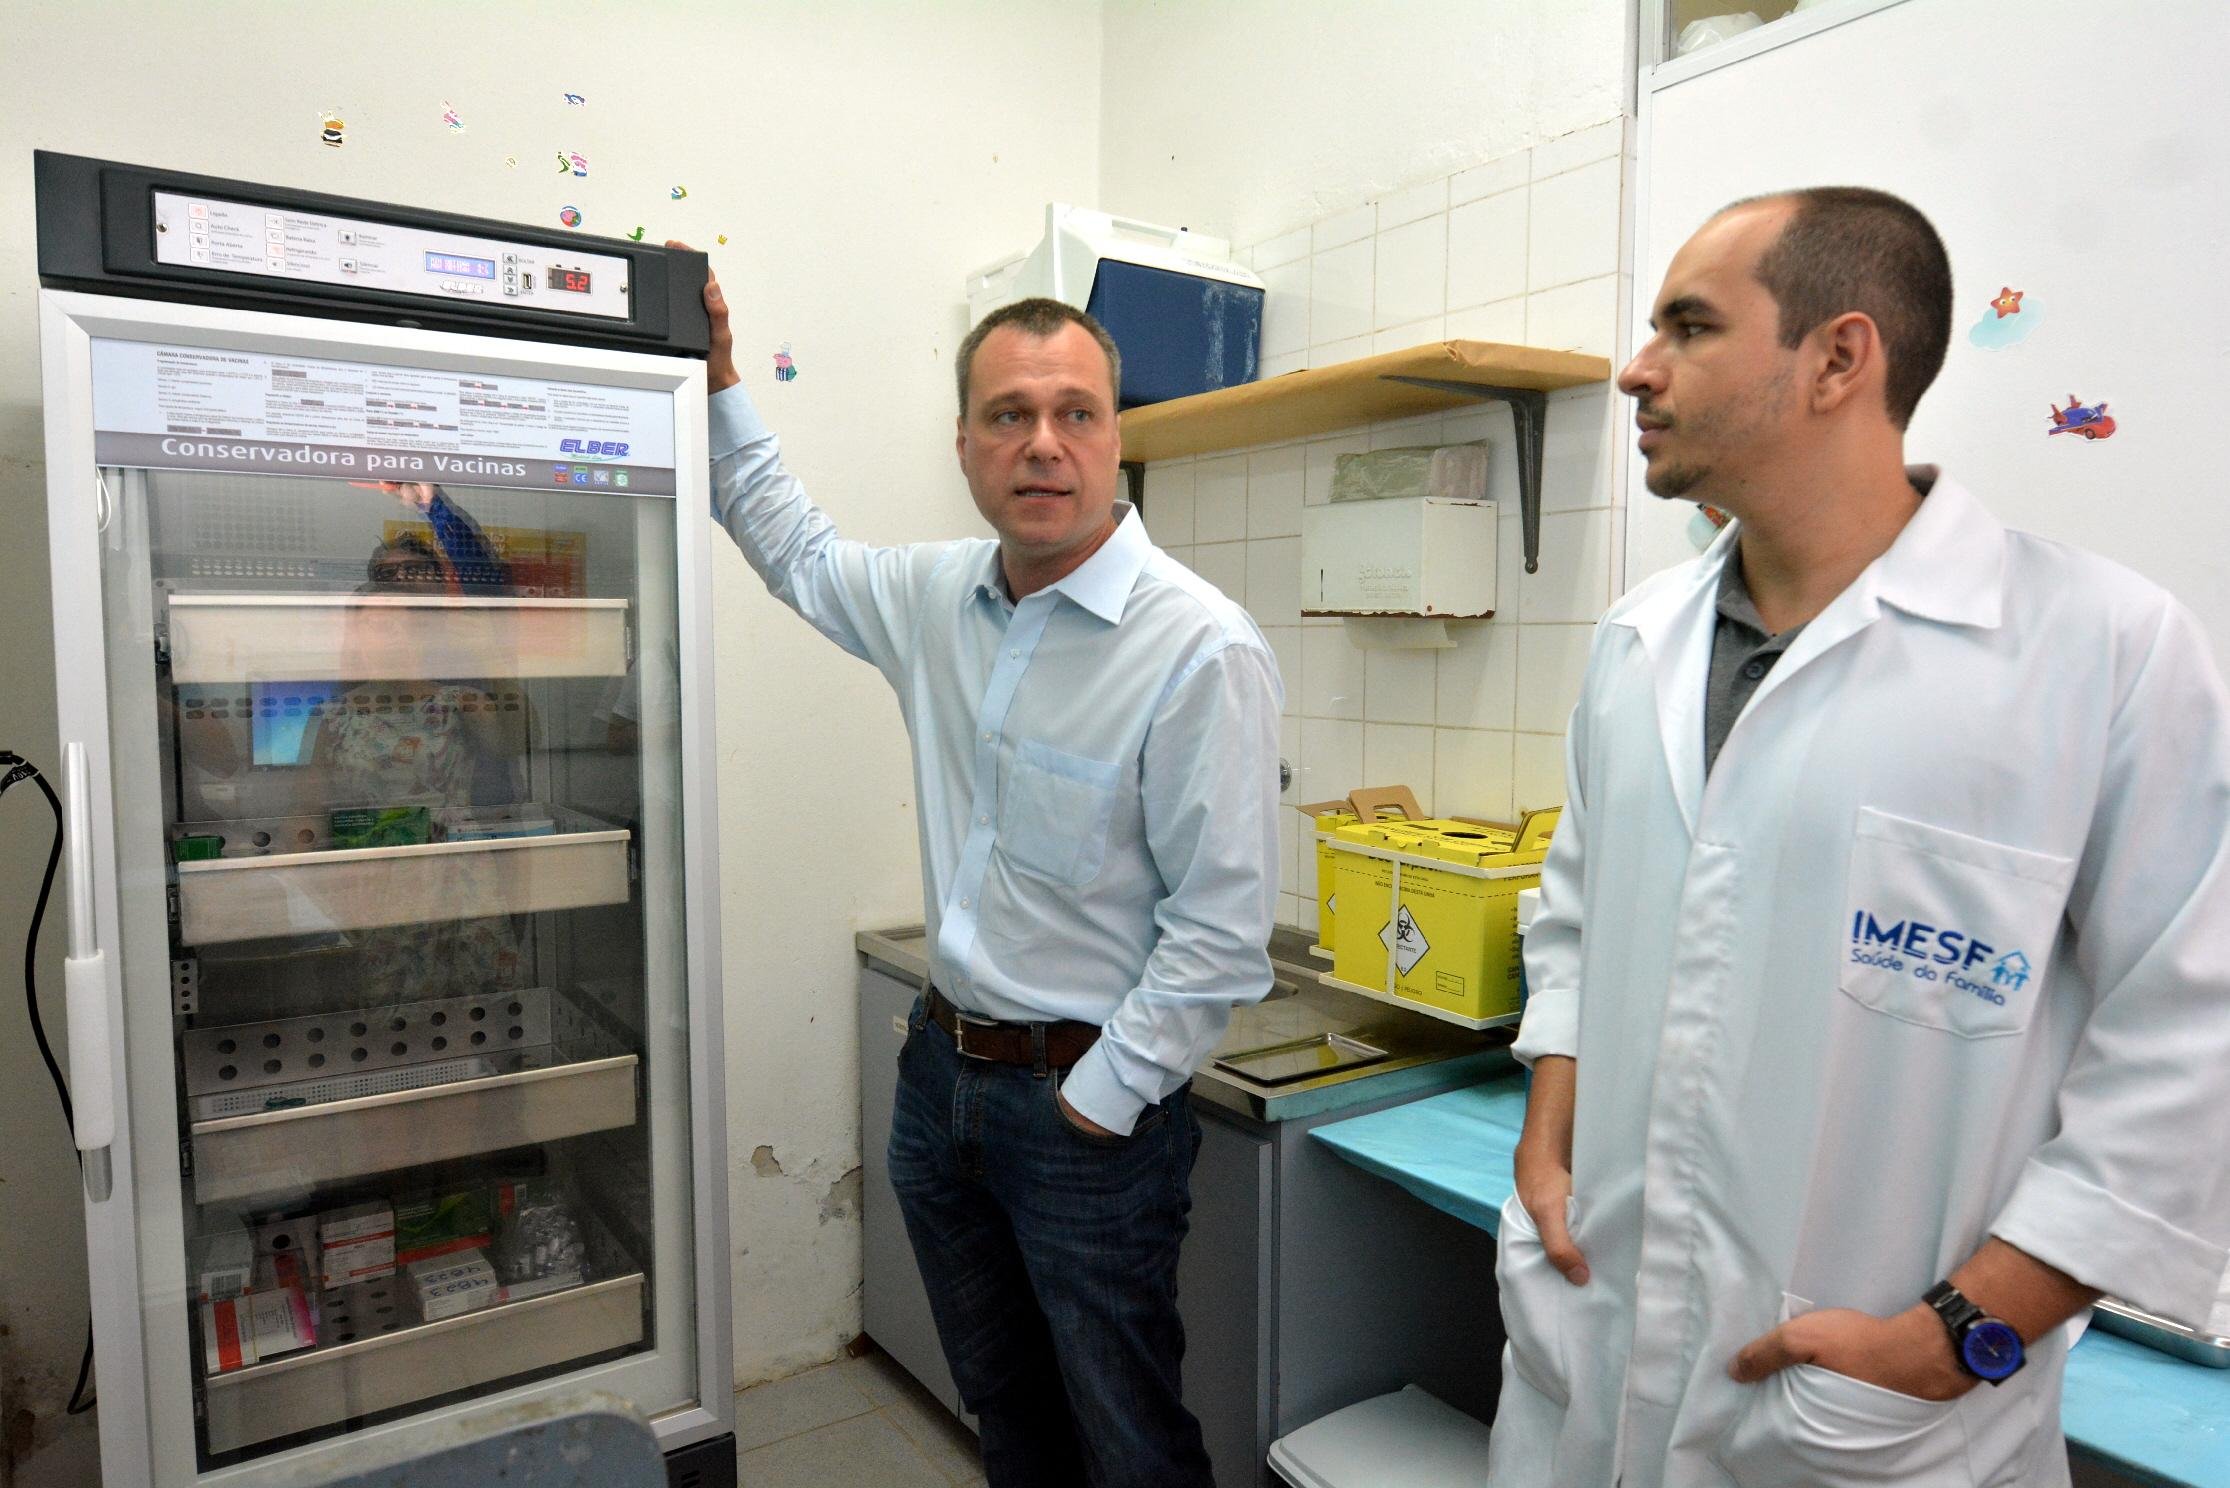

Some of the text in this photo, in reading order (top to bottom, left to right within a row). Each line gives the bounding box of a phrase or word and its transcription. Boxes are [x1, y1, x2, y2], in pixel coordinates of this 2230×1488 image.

[565, 273, 588, 291] 5.2
[161, 438, 526, 477] Conservadora para Vacinas
[560, 438, 629, 457] ELBER
[1852, 910, 1994, 970] IMESF
[1851, 948, 1904, 971] Saúde
